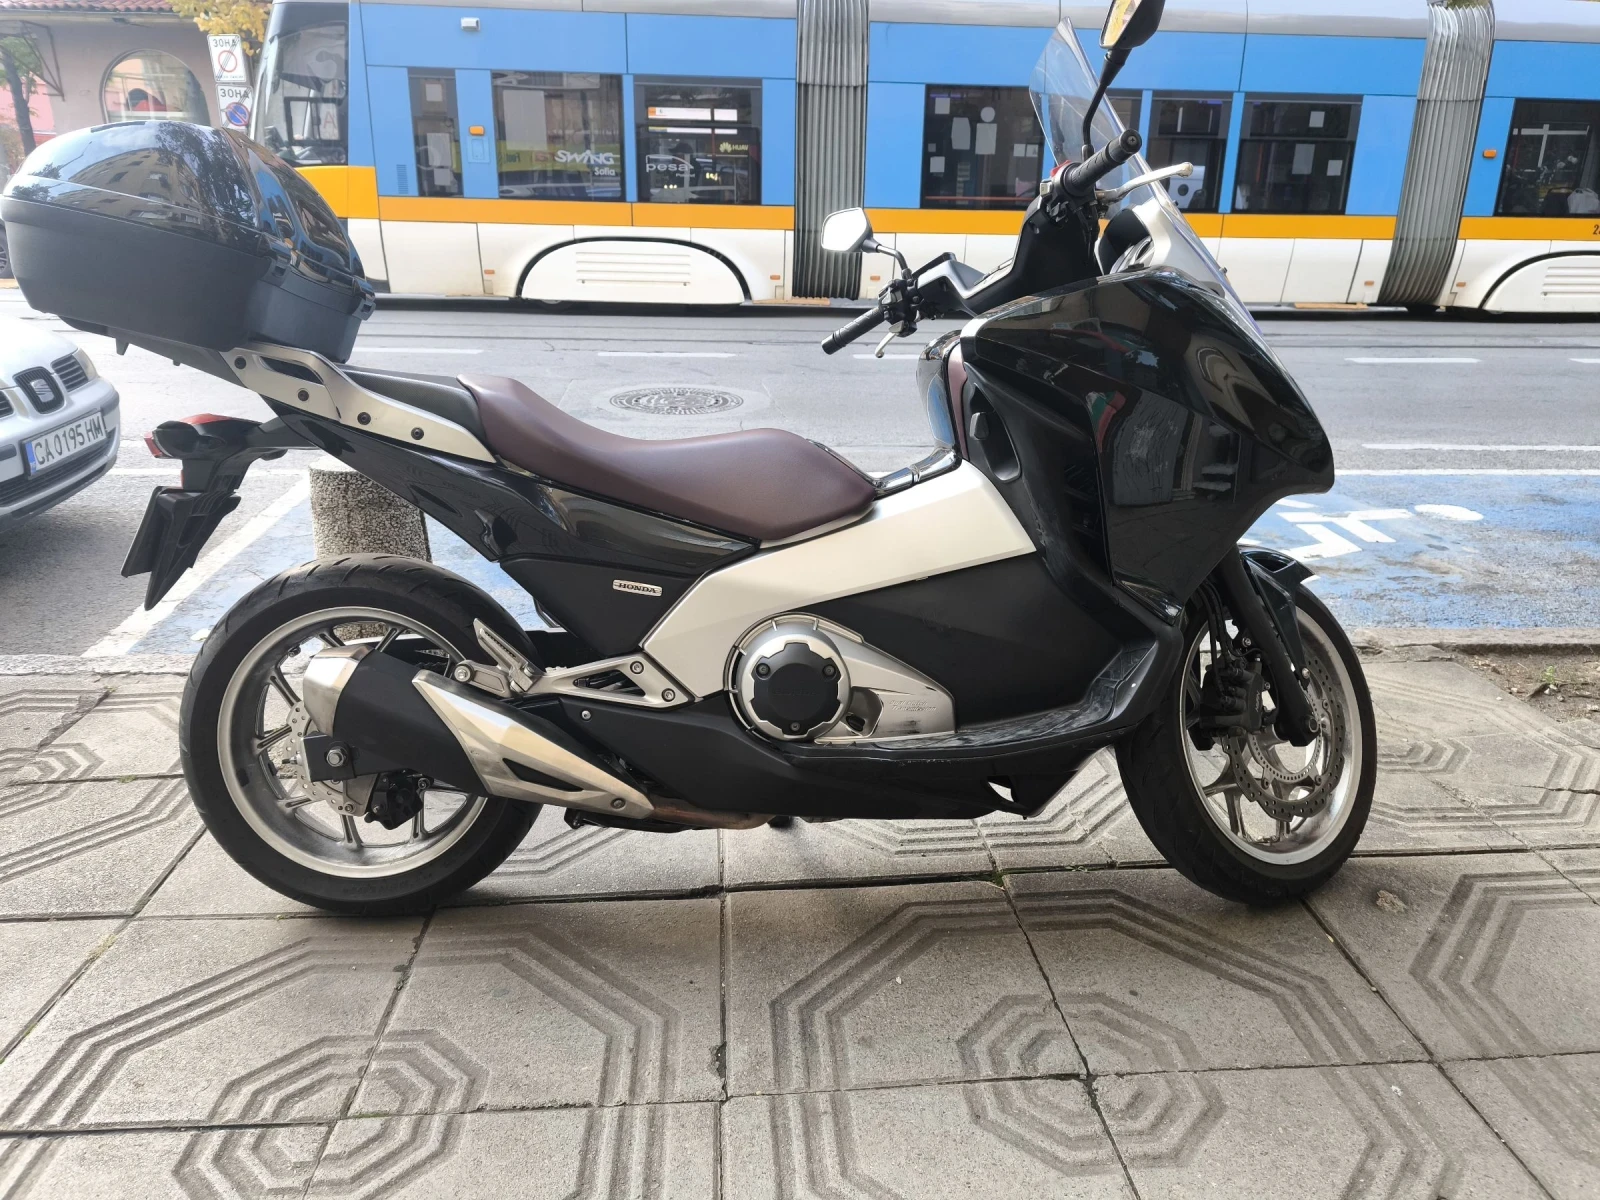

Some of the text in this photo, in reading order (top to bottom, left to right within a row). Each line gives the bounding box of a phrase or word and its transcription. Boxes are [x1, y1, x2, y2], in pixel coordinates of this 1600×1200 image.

[213, 39, 237, 48] ЗОНА
[220, 88, 250, 99] ЗОНА
[594, 166, 616, 177] Sofia
[646, 160, 690, 173] pesa
[1592, 223, 1600, 235] 2
[35, 415, 104, 465] CA 0195 HM
[619, 582, 657, 594] HONDA
